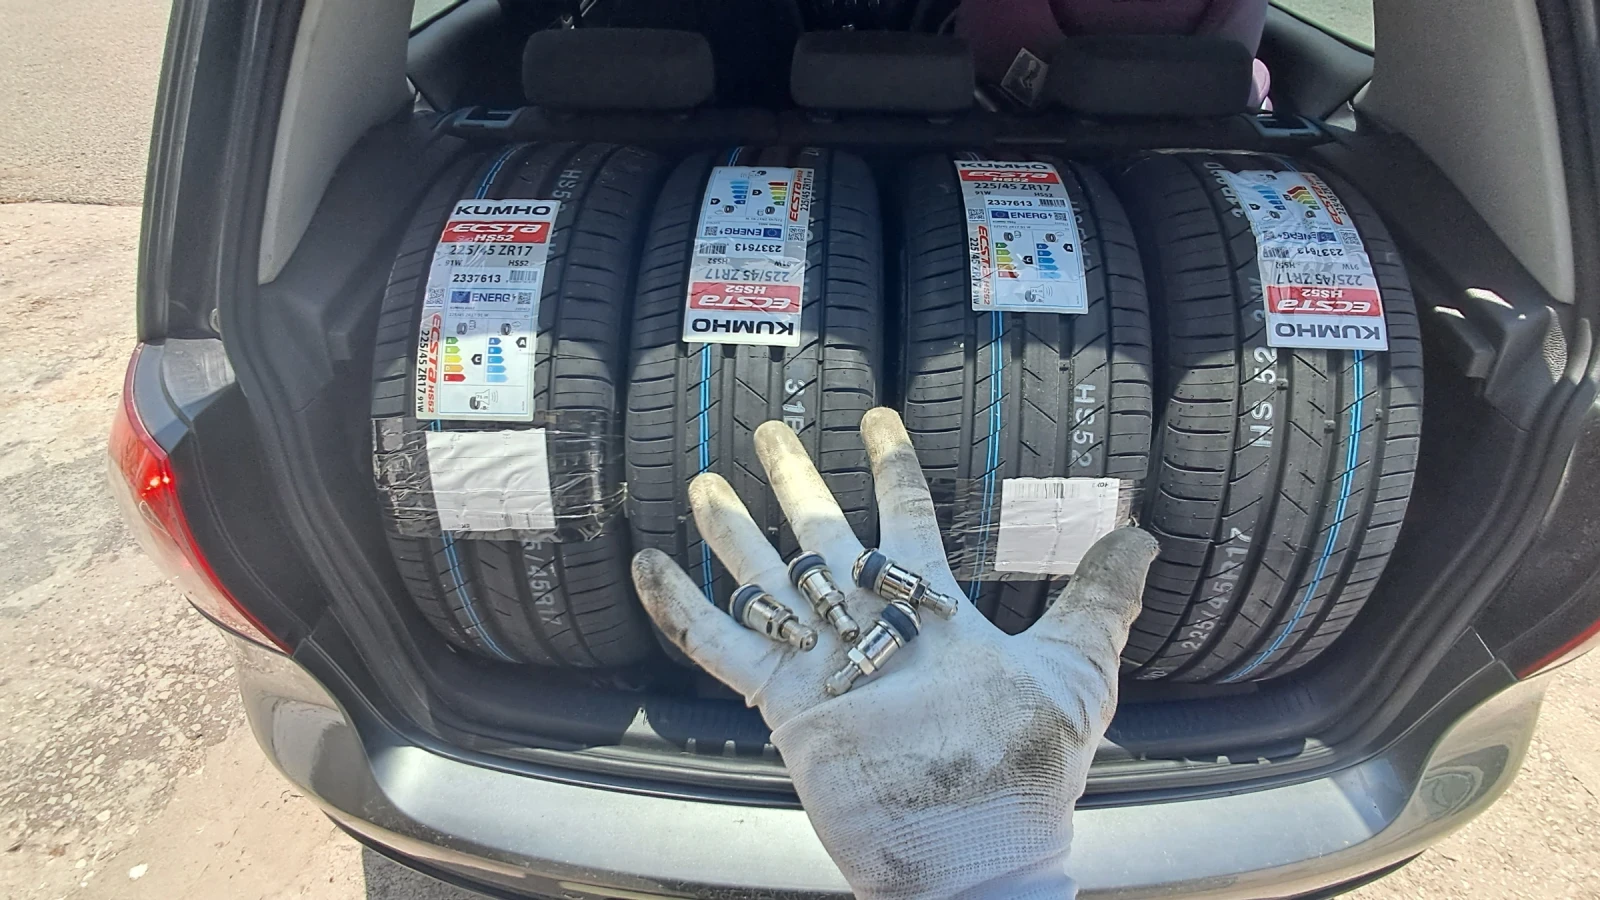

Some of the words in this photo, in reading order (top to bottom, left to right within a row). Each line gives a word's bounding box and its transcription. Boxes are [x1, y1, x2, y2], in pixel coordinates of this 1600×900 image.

[974, 182, 1017, 190] 225/45
[1020, 183, 1051, 192] ZR17
[987, 199, 1033, 207] 2337613
[455, 205, 551, 216] KUMHO
[724, 227, 762, 236] ENERG
[474, 234, 515, 242] HS52
[450, 245, 498, 255] 225/45
[498, 246, 533, 256] ZR17
[1297, 247, 1344, 257] 2337613
[452, 274, 501, 283] 2337613
[705, 268, 738, 281] ZR17
[743, 269, 790, 282] 225/45
[1277, 272, 1312, 285] ZR17
[1315, 274, 1362, 286] 225/45
[725, 285, 767, 294] HS52
[1301, 288, 1343, 298] HS52
[472, 293, 511, 302] ENERG
[692, 318, 794, 335] KUMHO
[1275, 322, 1380, 340] KUMHO
[419, 330, 430, 365] 225/45
[1254, 346, 1277, 385] 52
[417, 368, 427, 394] ZR17
[1072, 384, 1096, 467] HS52
[1249, 400, 1274, 448] HS
